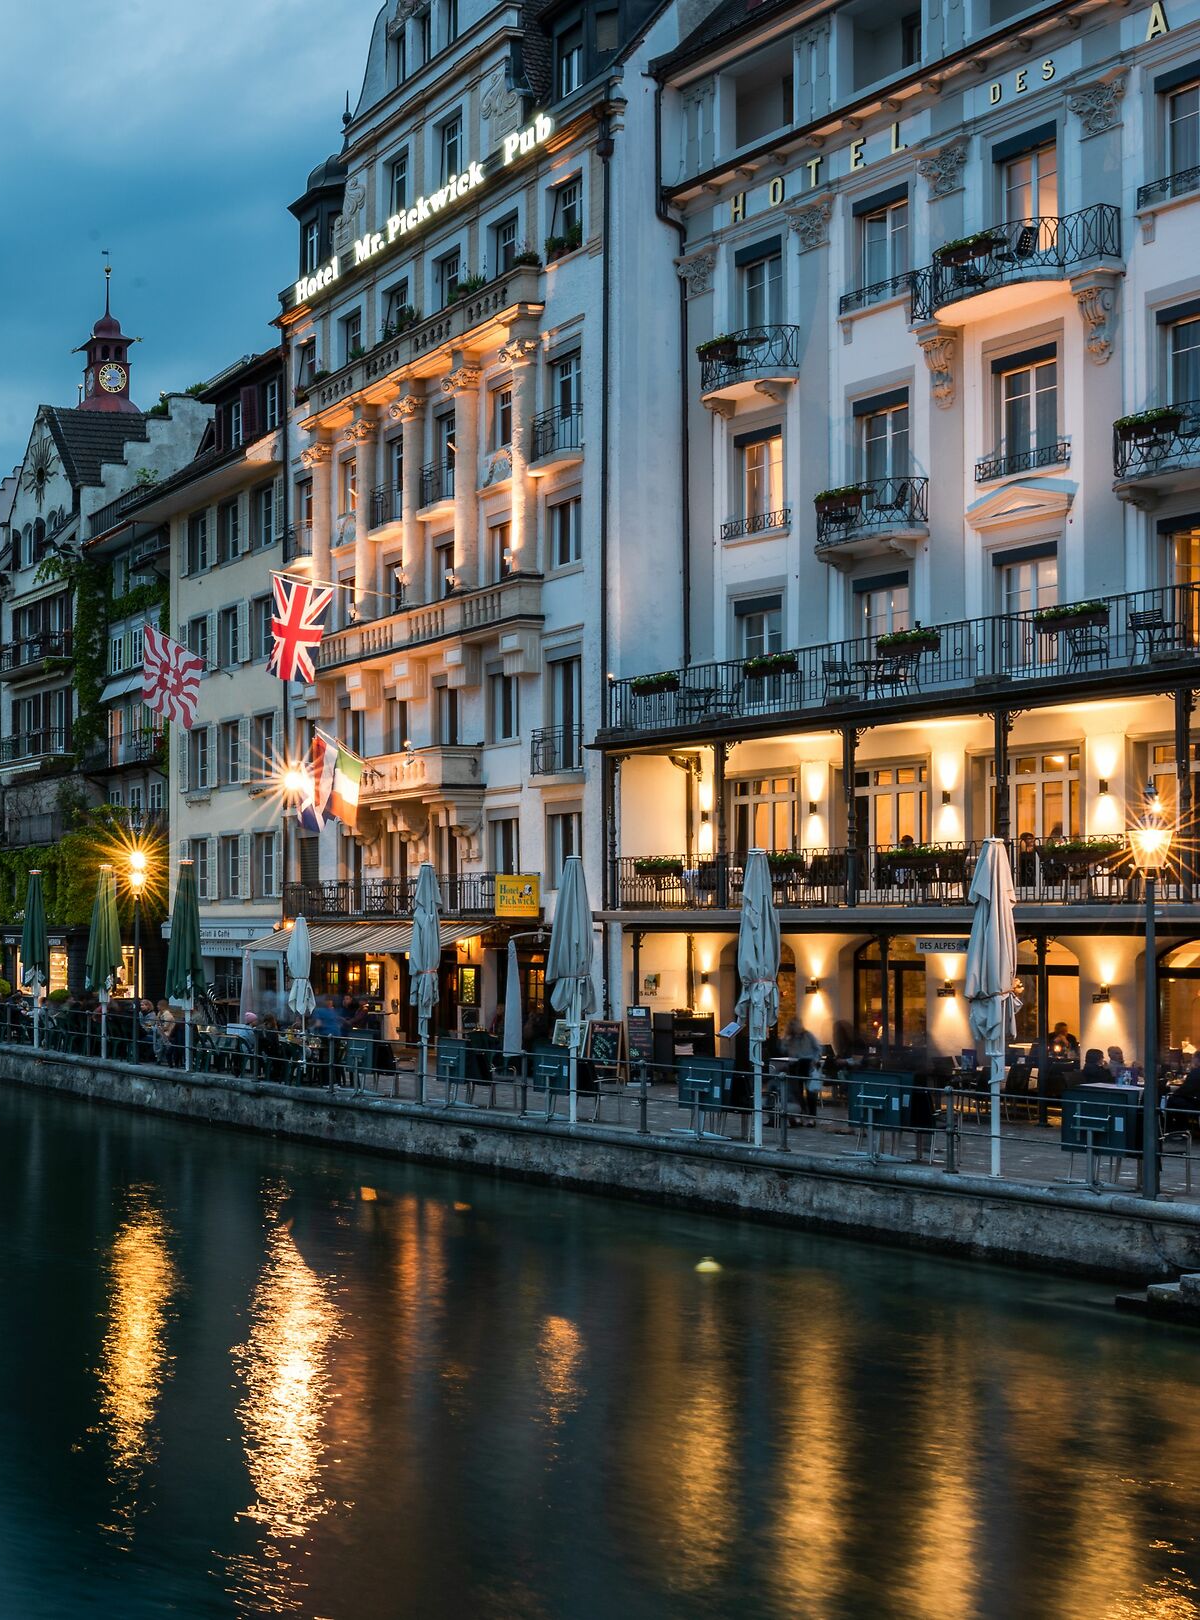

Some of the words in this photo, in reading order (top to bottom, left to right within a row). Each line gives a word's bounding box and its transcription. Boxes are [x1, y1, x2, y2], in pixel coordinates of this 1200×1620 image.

[731, 121, 908, 224] HOTEL
[989, 59, 1056, 105] DES
[295, 256, 340, 305] Hotel
[354, 232, 385, 266] Mr.
[387, 161, 486, 242] Pickwick
[503, 113, 552, 166] Pub
[500, 884, 519, 894] Hotel
[500, 895, 535, 905] Pickwick
[920, 942, 932, 950] DES
[934, 942, 956, 950] ALPES
